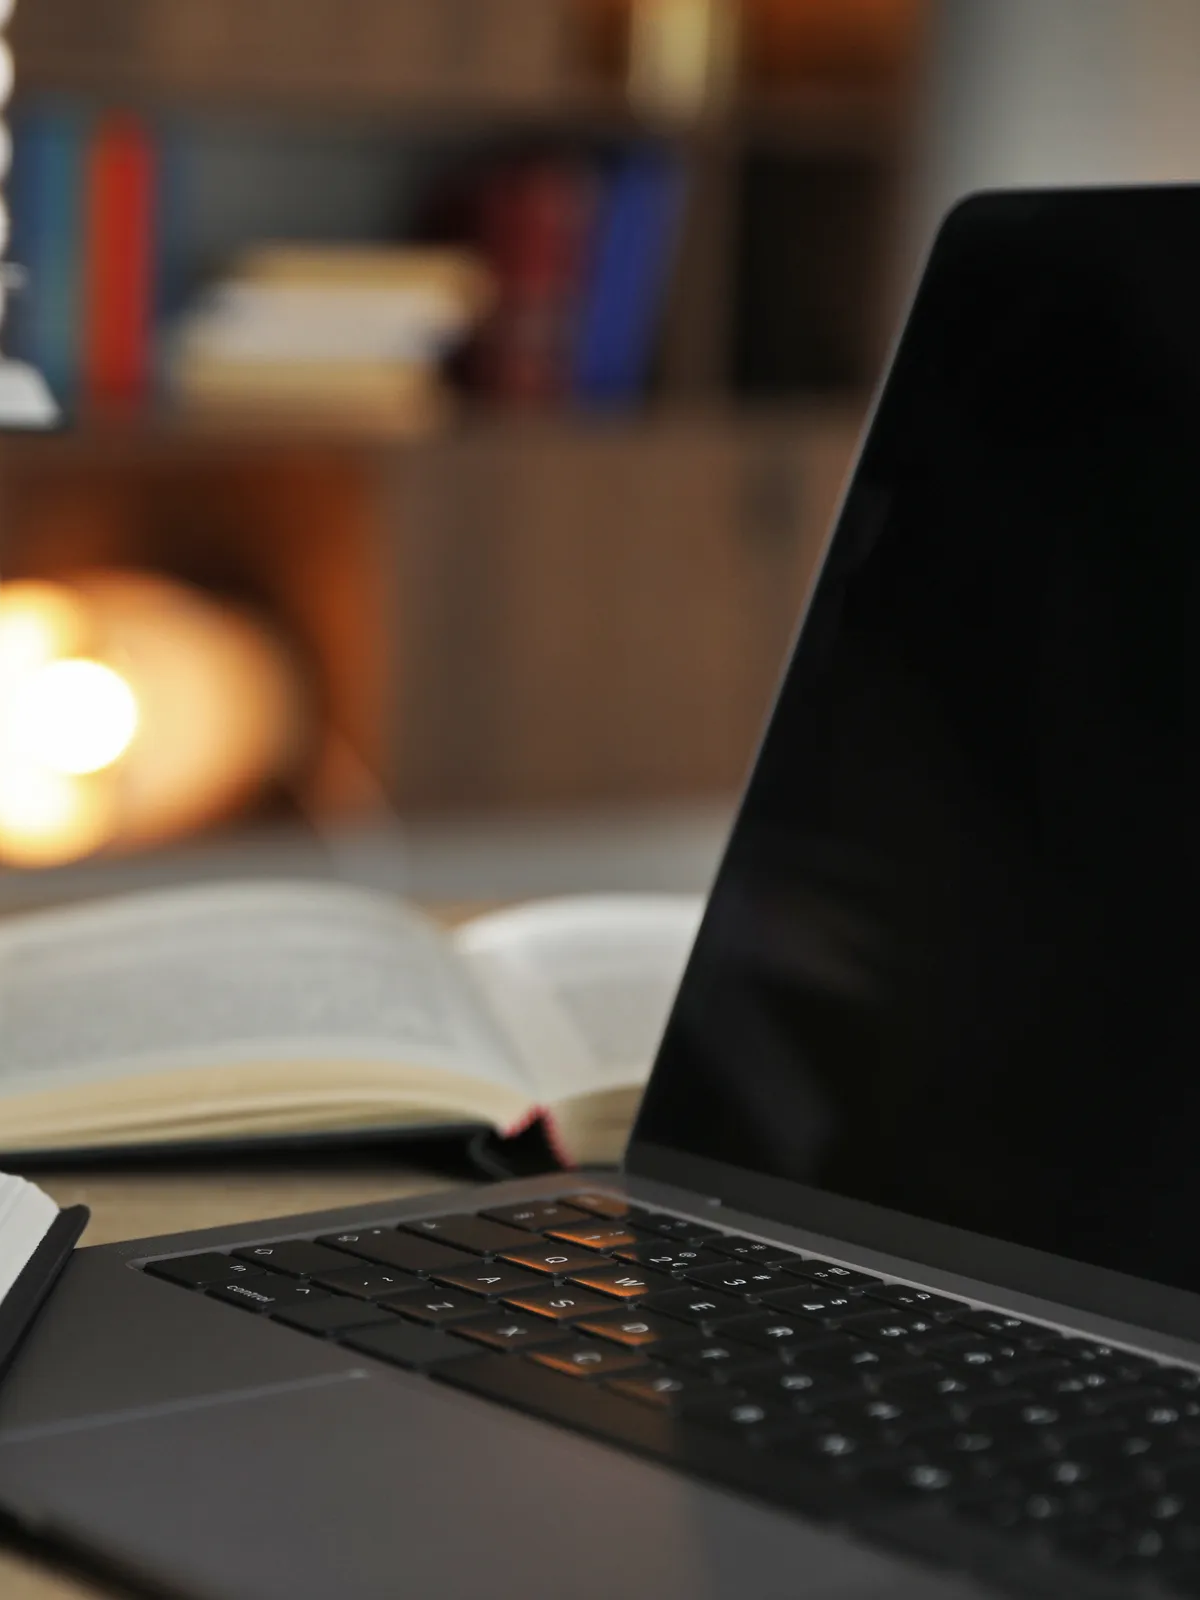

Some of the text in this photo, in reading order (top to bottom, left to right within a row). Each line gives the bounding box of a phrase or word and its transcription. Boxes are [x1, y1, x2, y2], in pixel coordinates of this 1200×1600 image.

[545, 1256, 568, 1264] Q
[477, 1275, 501, 1284] A
[615, 1277, 645, 1287] W
[724, 1278, 747, 1286] 3
[226, 1285, 276, 1302] control
[426, 1301, 454, 1311] Z
[550, 1299, 575, 1308] S
[689, 1302, 716, 1311] E
[621, 1322, 649, 1333] D
